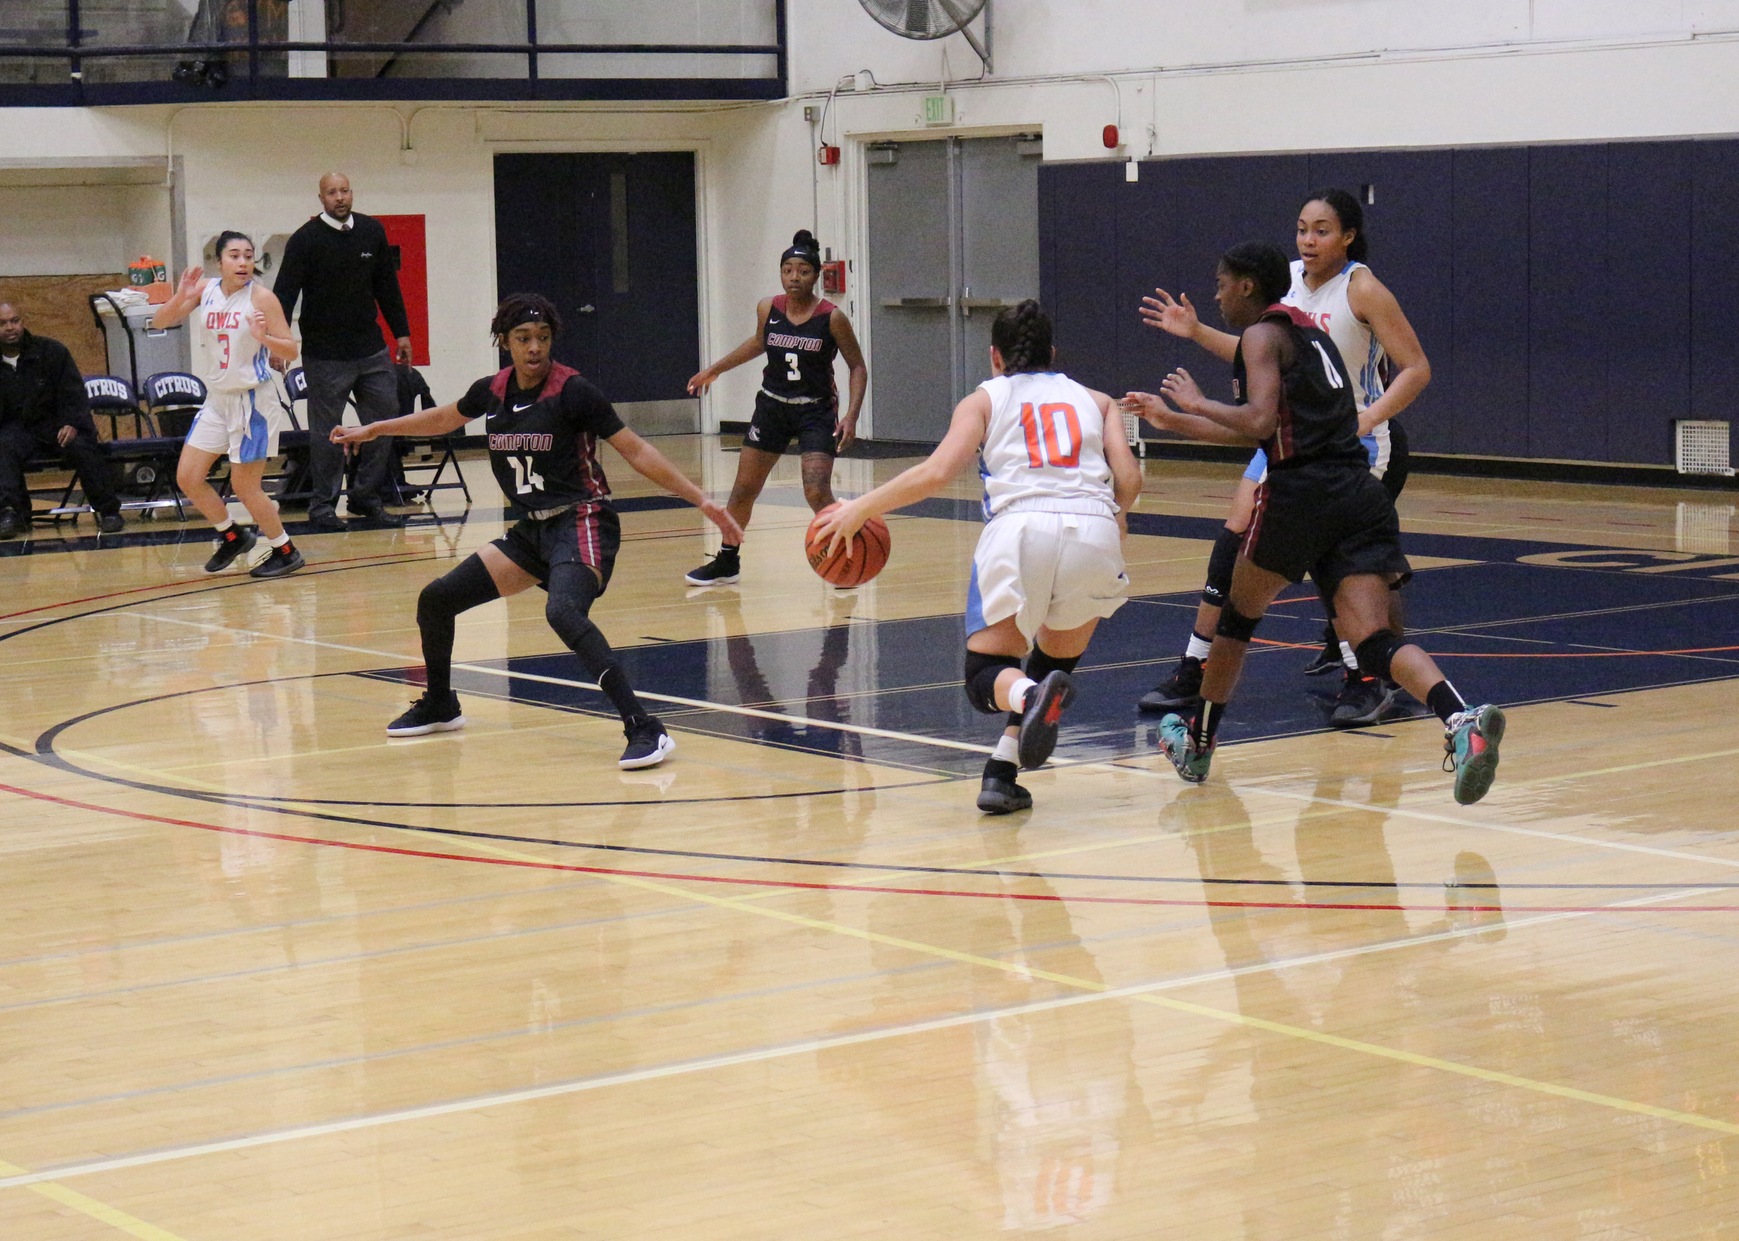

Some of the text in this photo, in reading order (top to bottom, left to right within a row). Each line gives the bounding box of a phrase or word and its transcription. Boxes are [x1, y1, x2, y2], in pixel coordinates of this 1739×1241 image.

[926, 97, 944, 121] EXIT
[206, 311, 241, 330] OWLS
[217, 333, 230, 370] 3
[767, 332, 823, 351] COMPTON
[785, 352, 801, 381] 3
[84, 378, 128, 400] ITRUS
[154, 375, 201, 398] CITRUS
[489, 433, 553, 451] COMPTON
[1019, 402, 1082, 469] 10
[506, 455, 545, 495] 24
